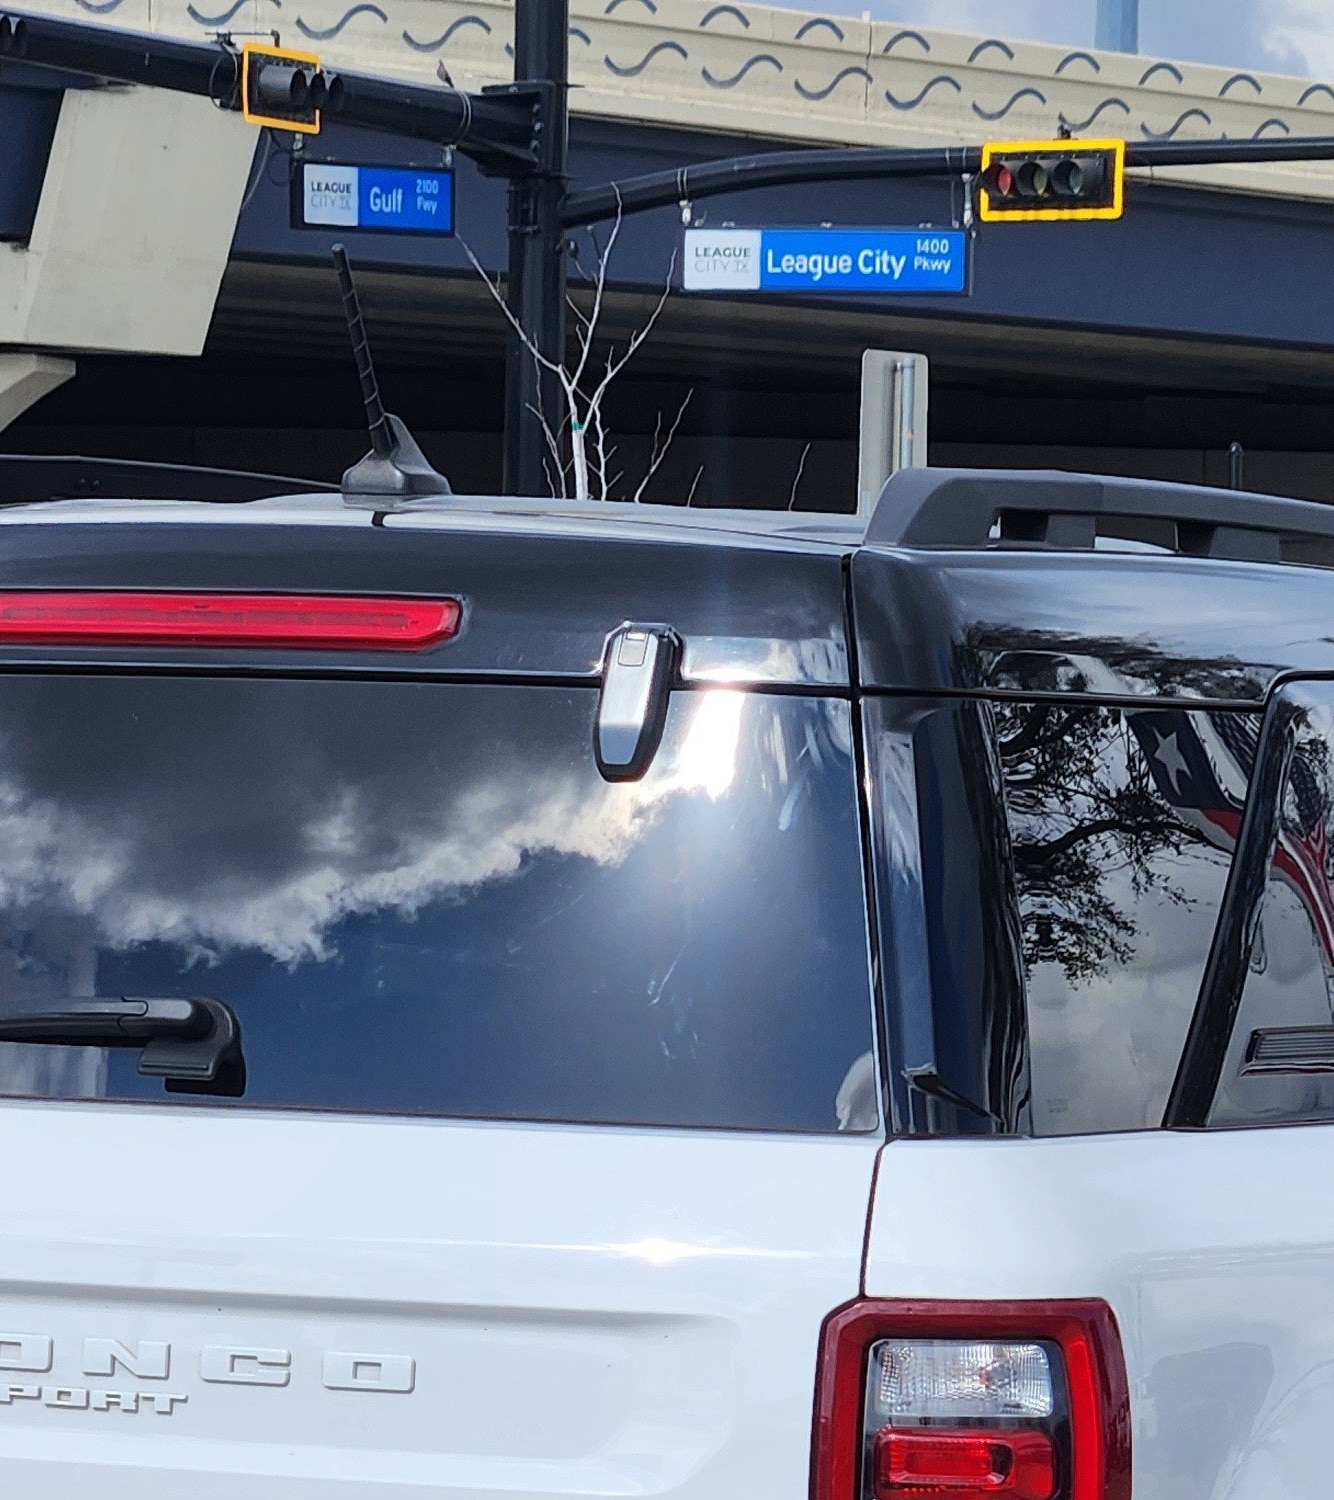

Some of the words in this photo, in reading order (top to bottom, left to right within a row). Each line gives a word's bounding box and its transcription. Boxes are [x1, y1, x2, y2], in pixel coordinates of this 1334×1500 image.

[311, 181, 351, 194] LEAGUE
[416, 178, 439, 194] 2100
[369, 186, 403, 213] Gulf
[416, 197, 437, 215] Fwy
[694, 247, 751, 258] LEAGUE
[917, 239, 949, 254] 1400
[694, 259, 729, 273] CITY
[767, 248, 853, 281] League
[857, 249, 906, 280] City
[914, 256, 951, 274] Pkwy
